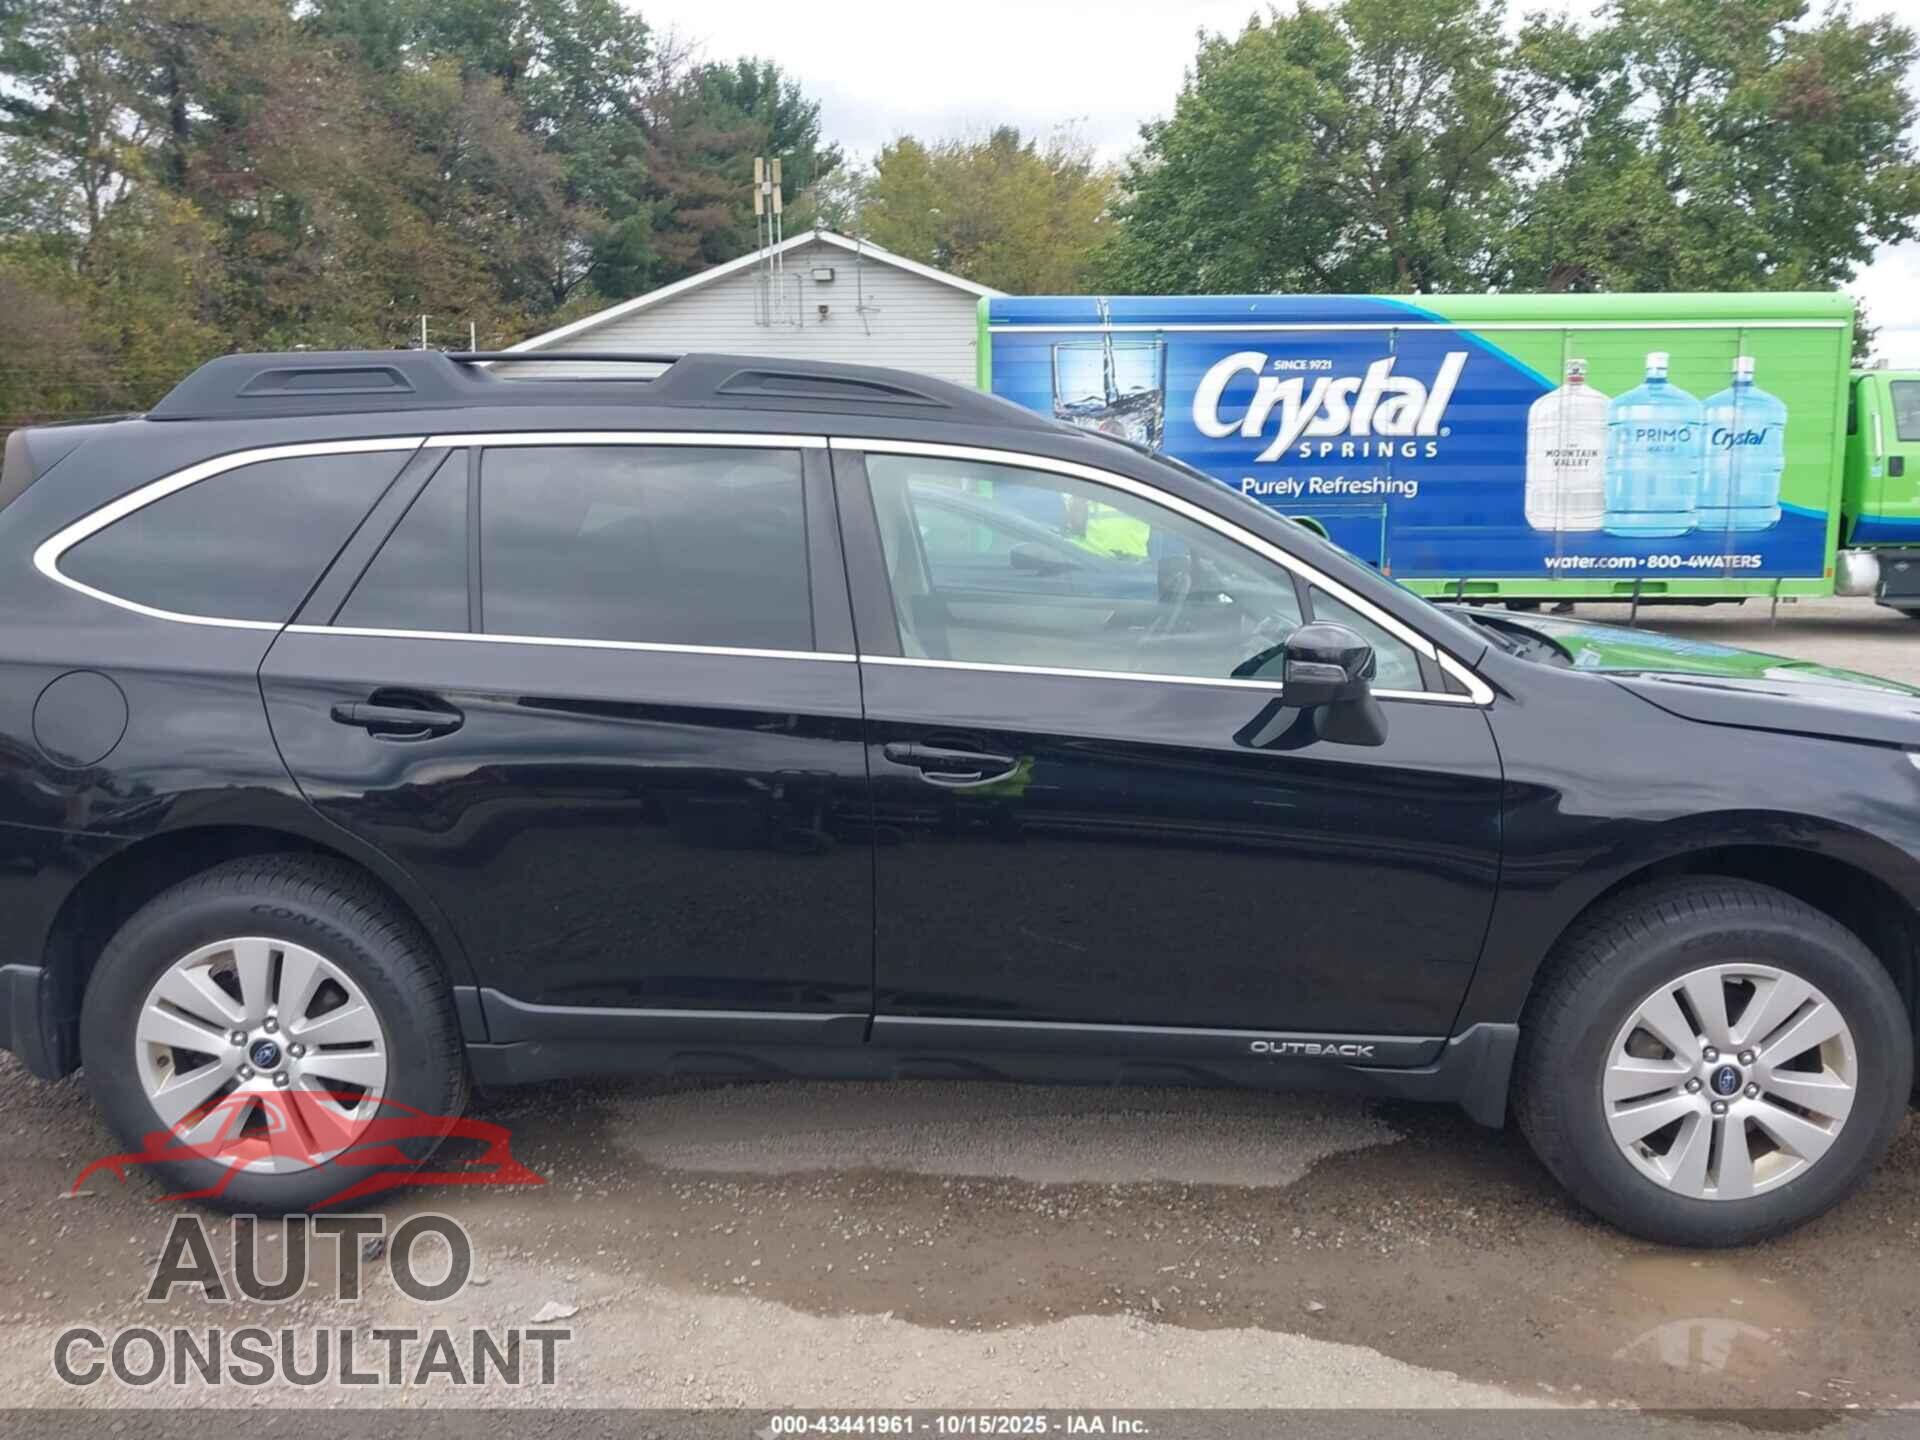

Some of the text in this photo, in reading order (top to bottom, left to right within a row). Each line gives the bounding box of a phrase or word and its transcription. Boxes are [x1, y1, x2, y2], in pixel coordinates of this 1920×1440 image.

[1273, 359, 1307, 370] SINCE
[1192, 351, 1468, 462] Crystal
[1635, 428, 1692, 443] PRIMO
[1711, 428, 1767, 449] Crystal
[1300, 441, 1437, 458] SPRINGS
[1242, 476, 1419, 498] Purely Refreshing
[1647, 555, 1762, 568] 800-4WATERS
[1250, 1041, 1375, 1057] OUTBACK
